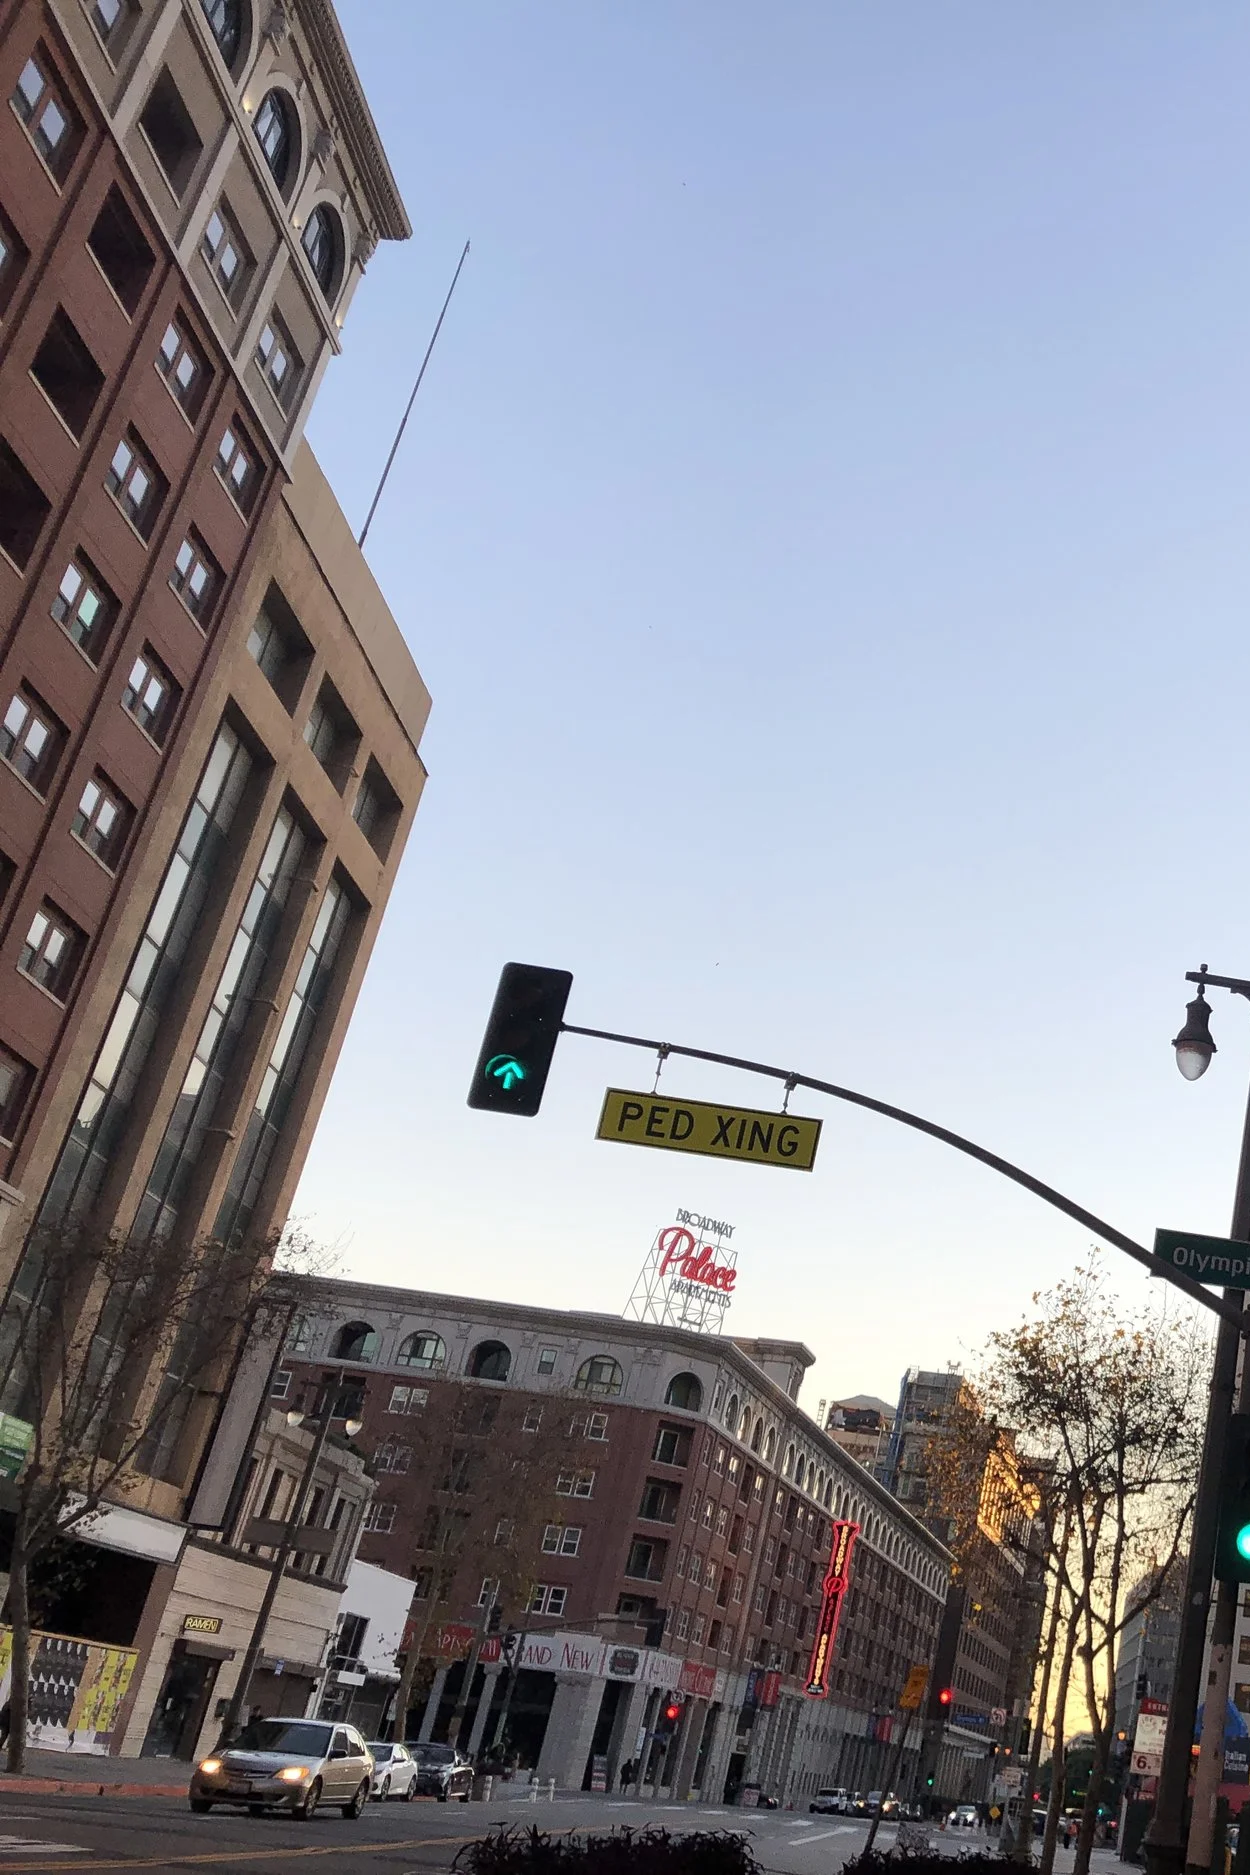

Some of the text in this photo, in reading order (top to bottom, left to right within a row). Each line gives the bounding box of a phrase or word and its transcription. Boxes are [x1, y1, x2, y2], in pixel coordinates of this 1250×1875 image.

[617, 1101, 801, 1157] PED XING
[676, 1207, 736, 1239] BROADWAY
[658, 1226, 737, 1292] Palace
[186, 1615, 218, 1633] RAMEN
[560, 1642, 595, 1671] NEW
[1225, 1750, 1247, 1762] Italian
